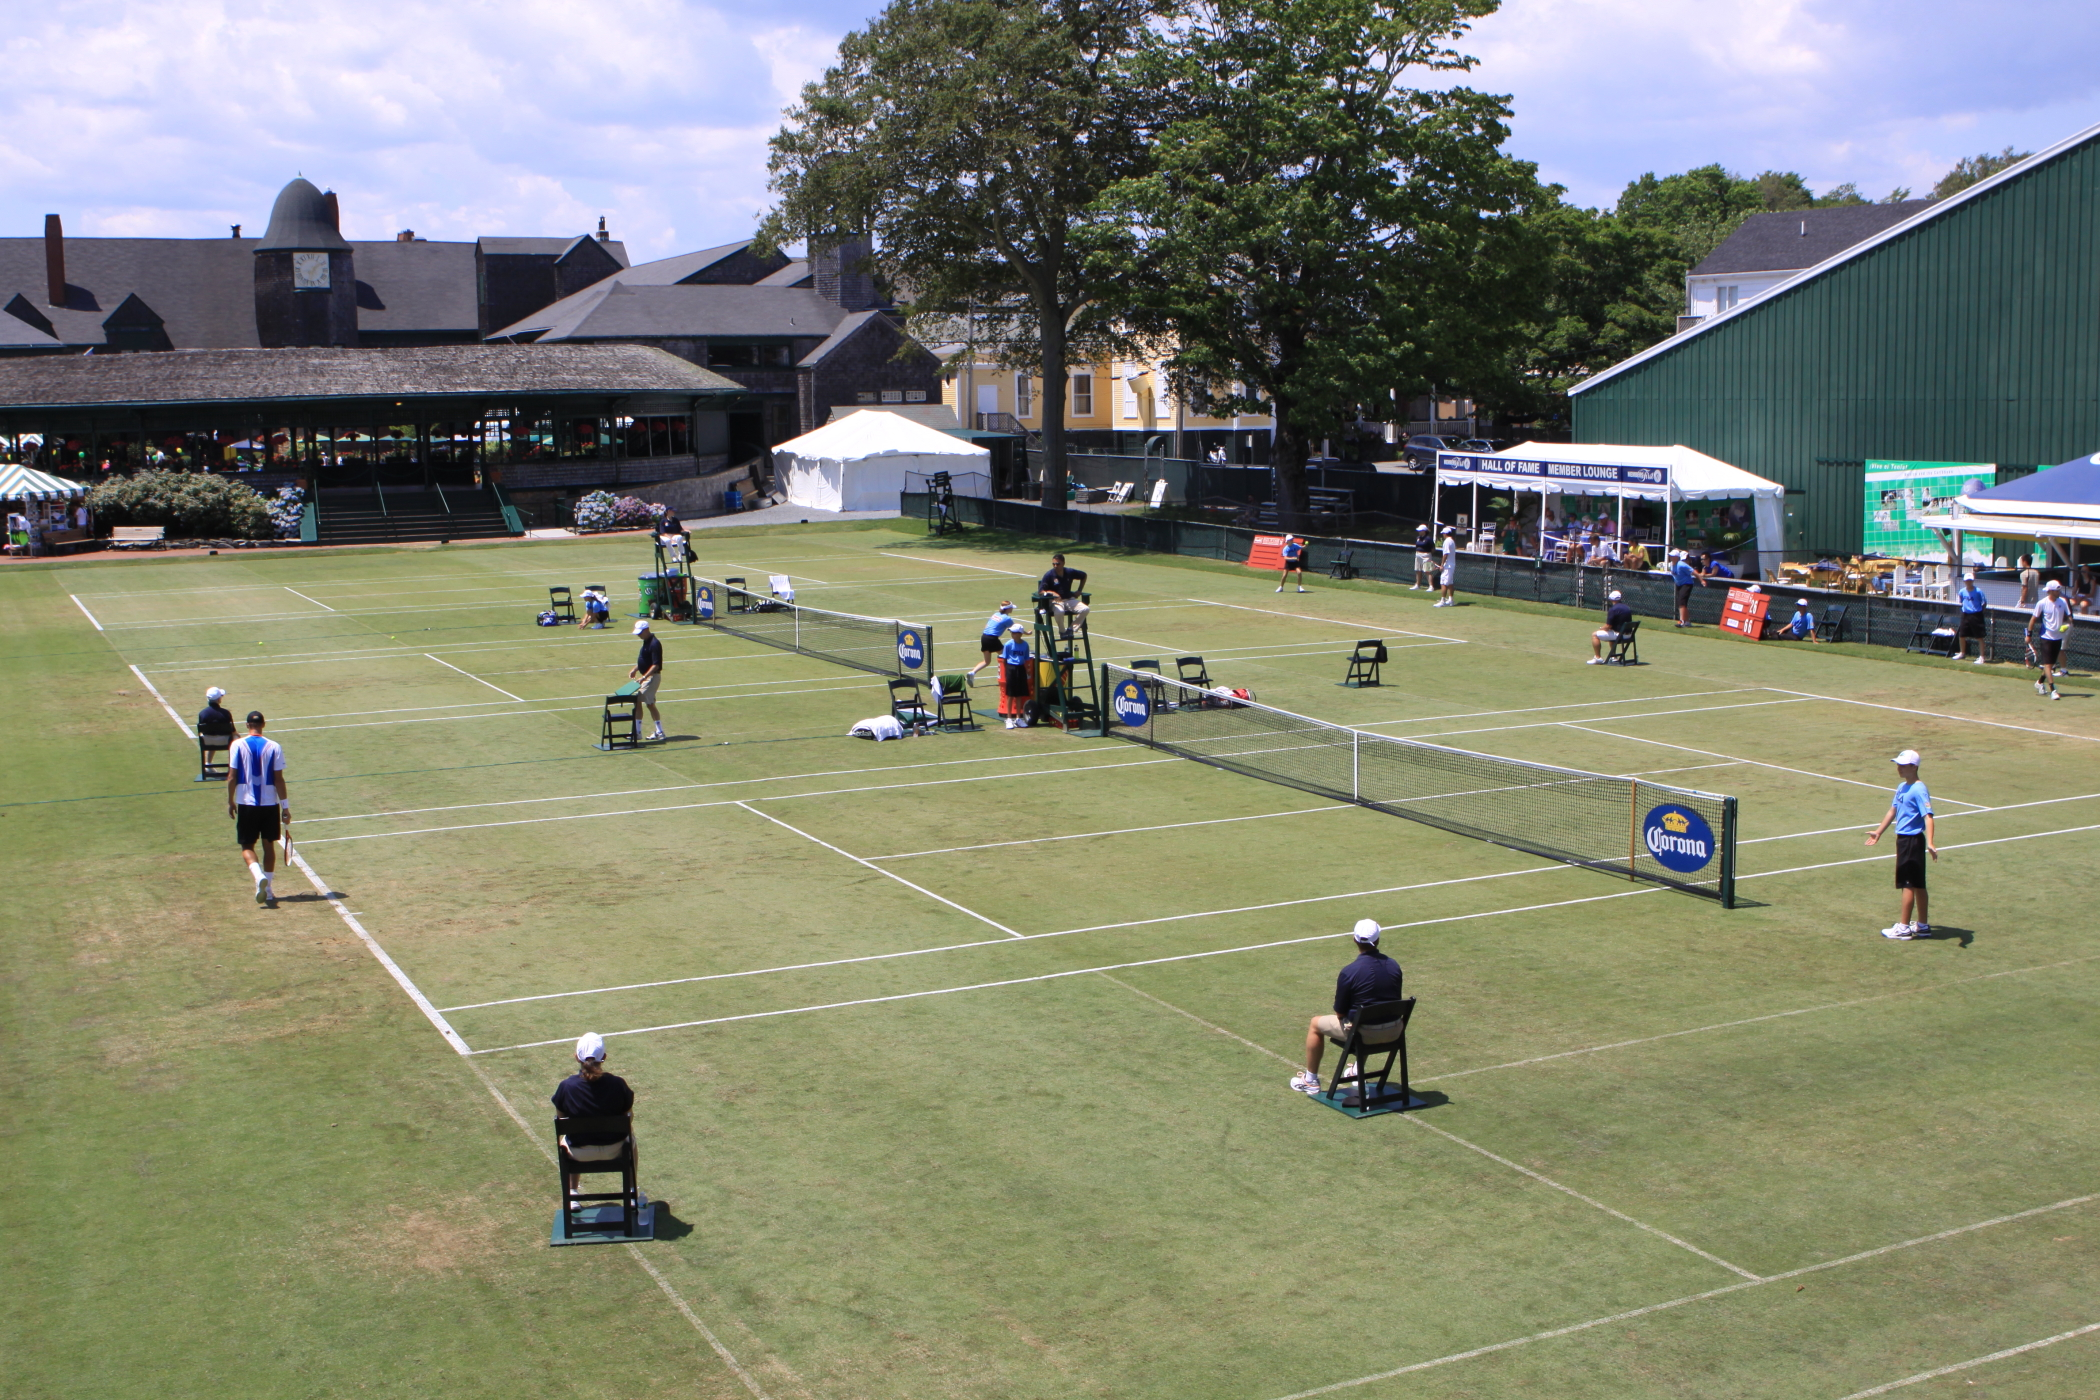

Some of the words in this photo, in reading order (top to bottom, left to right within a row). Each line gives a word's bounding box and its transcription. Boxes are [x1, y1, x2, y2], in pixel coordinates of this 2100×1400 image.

[1482, 460, 1503, 471] HALL
[1504, 461, 1516, 472] OF
[1517, 461, 1540, 474] FAME
[1547, 464, 1582, 477] MEMBER
[1583, 466, 1618, 479] LOUNGE
[899, 643, 921, 661] Corona
[1115, 696, 1146, 717] Corona
[1647, 826, 1707, 858] Corona
